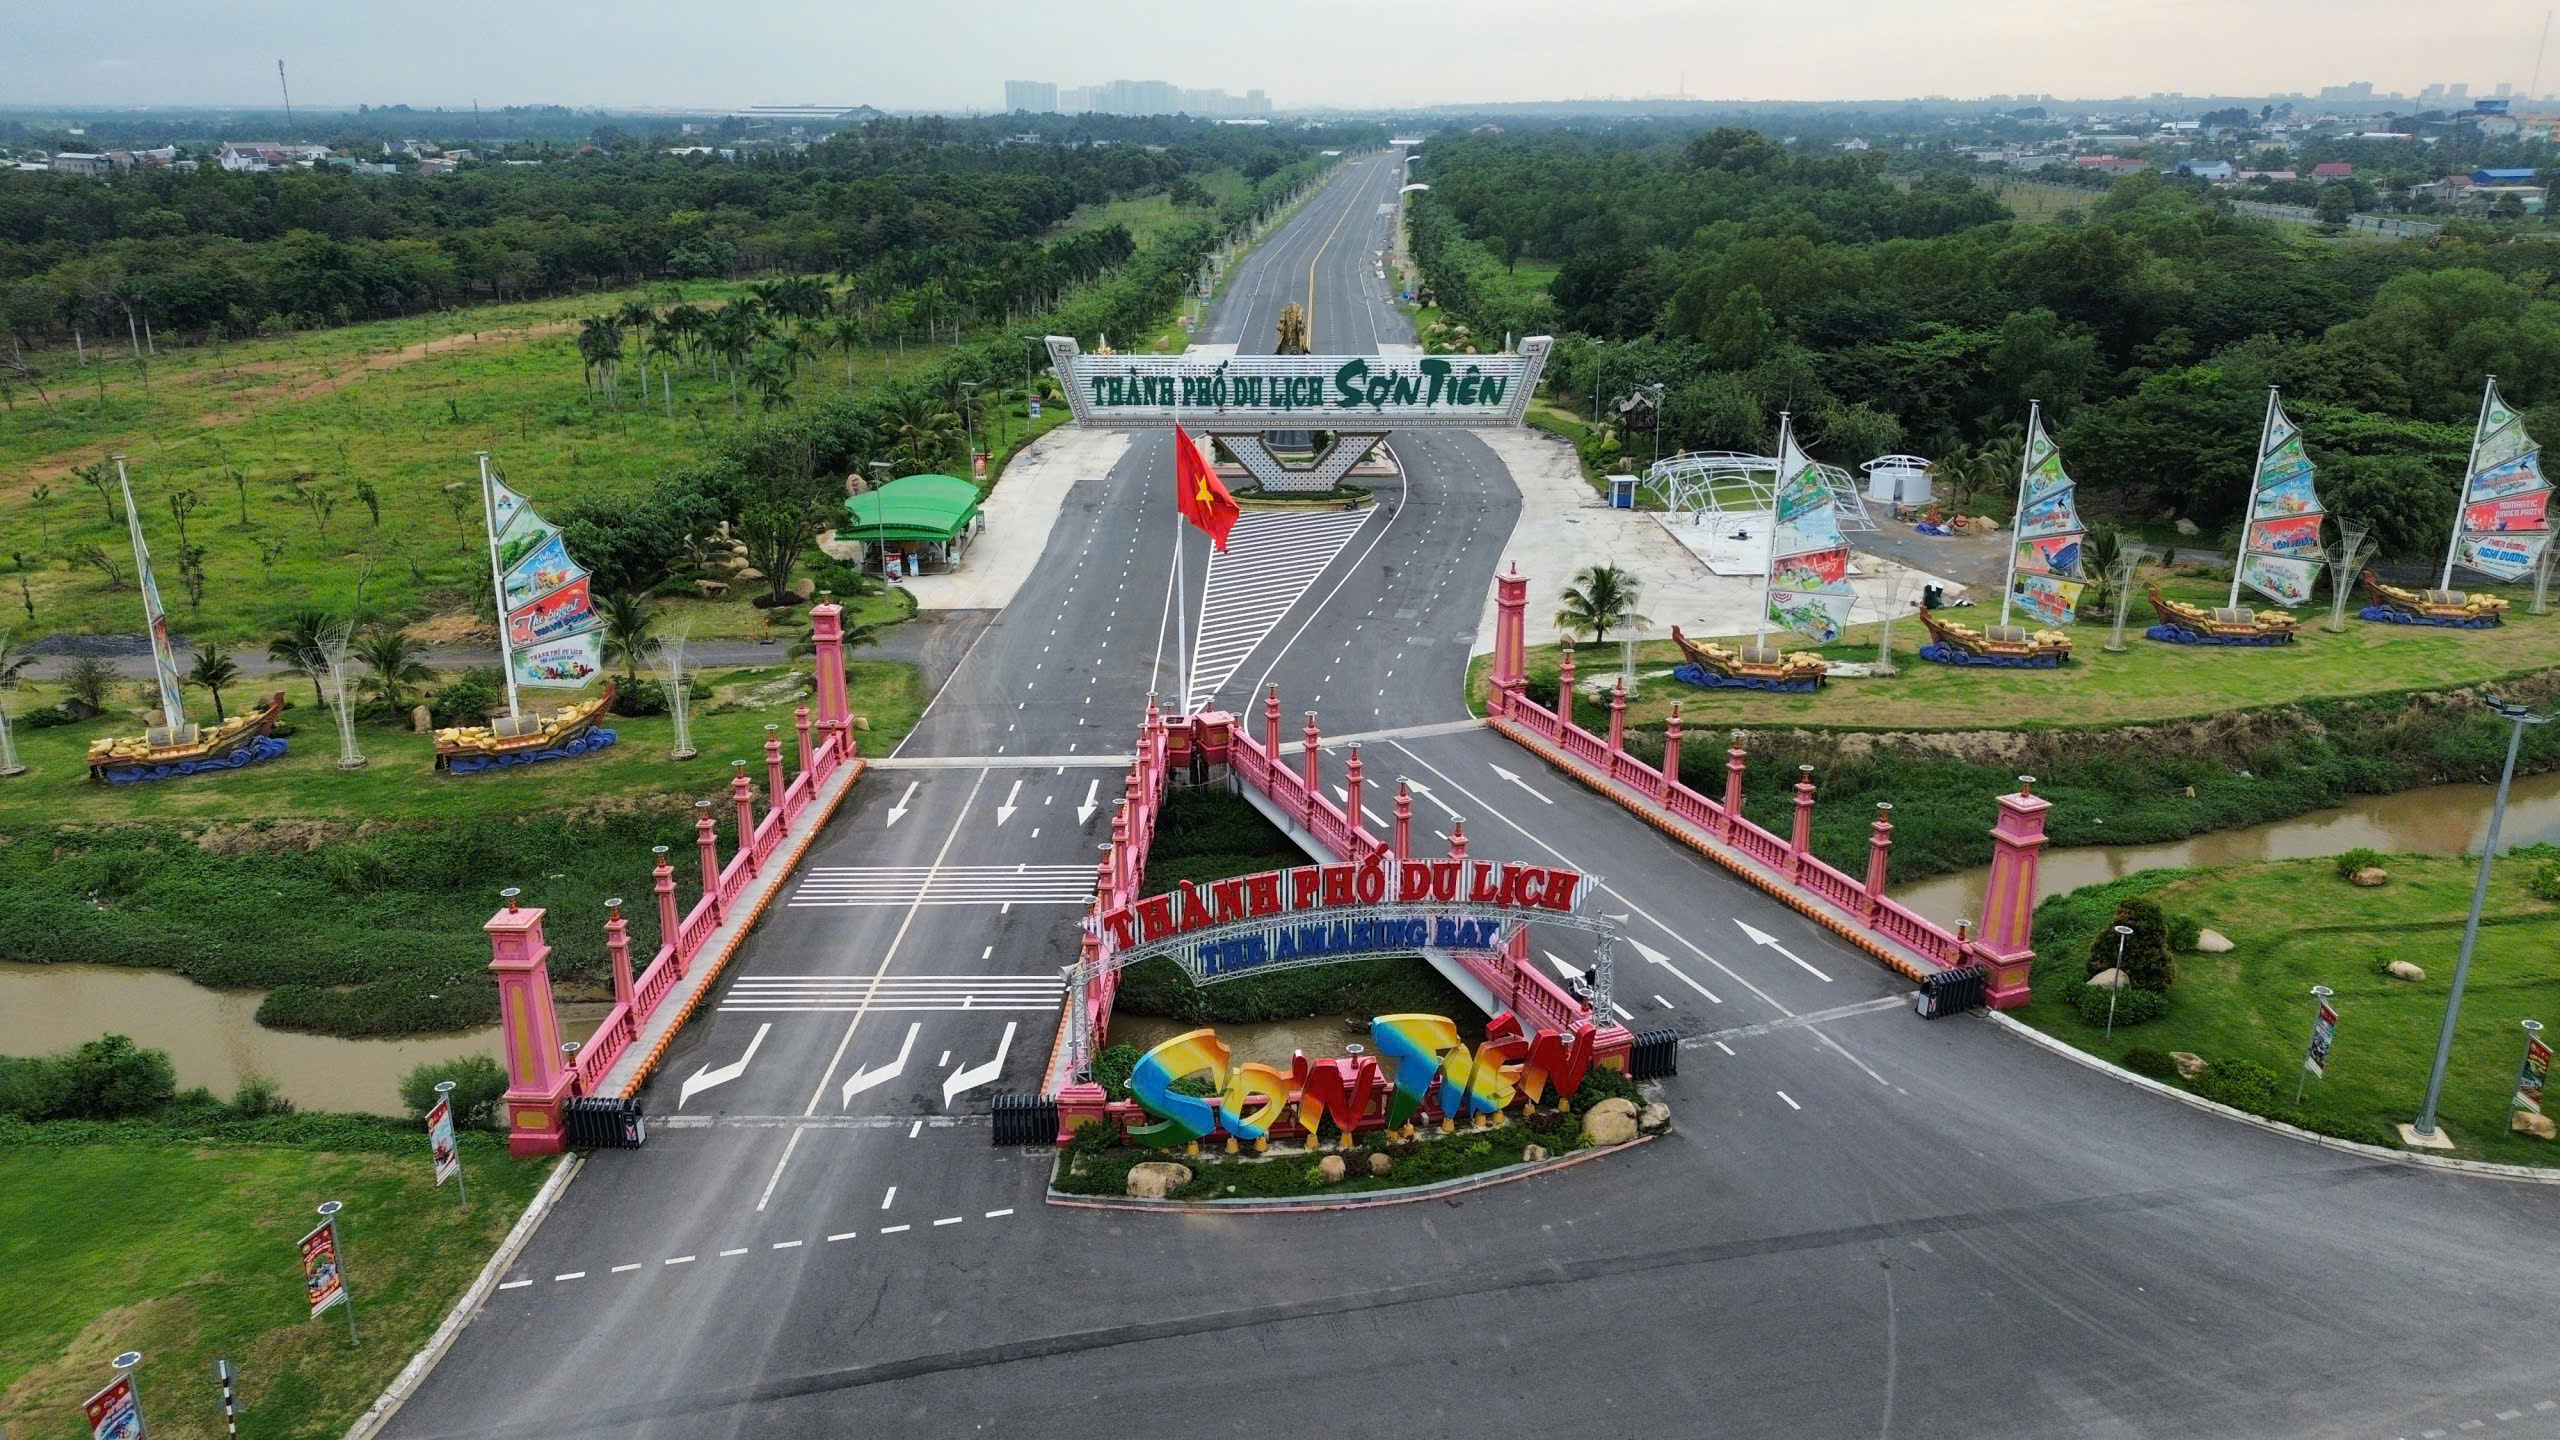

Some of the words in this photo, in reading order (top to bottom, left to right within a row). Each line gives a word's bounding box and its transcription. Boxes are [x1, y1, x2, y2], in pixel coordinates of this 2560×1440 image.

[1091, 366, 1175, 406] THÀNH
[1181, 359, 1229, 406] PHỐ
[1233, 375, 1262, 406] DU
[1269, 375, 1324, 412] LỊCH
[514, 611, 545, 632] The
[1104, 871, 1282, 950] THÀNH
[1292, 840, 1389, 908] PHỐ
[1400, 860, 1463, 901] DU
[1468, 861, 1581, 912] LỊCH
[1200, 934, 1268, 975] THE
[1277, 918, 1428, 960] AMAZING
[1434, 917, 1500, 949] BAY
